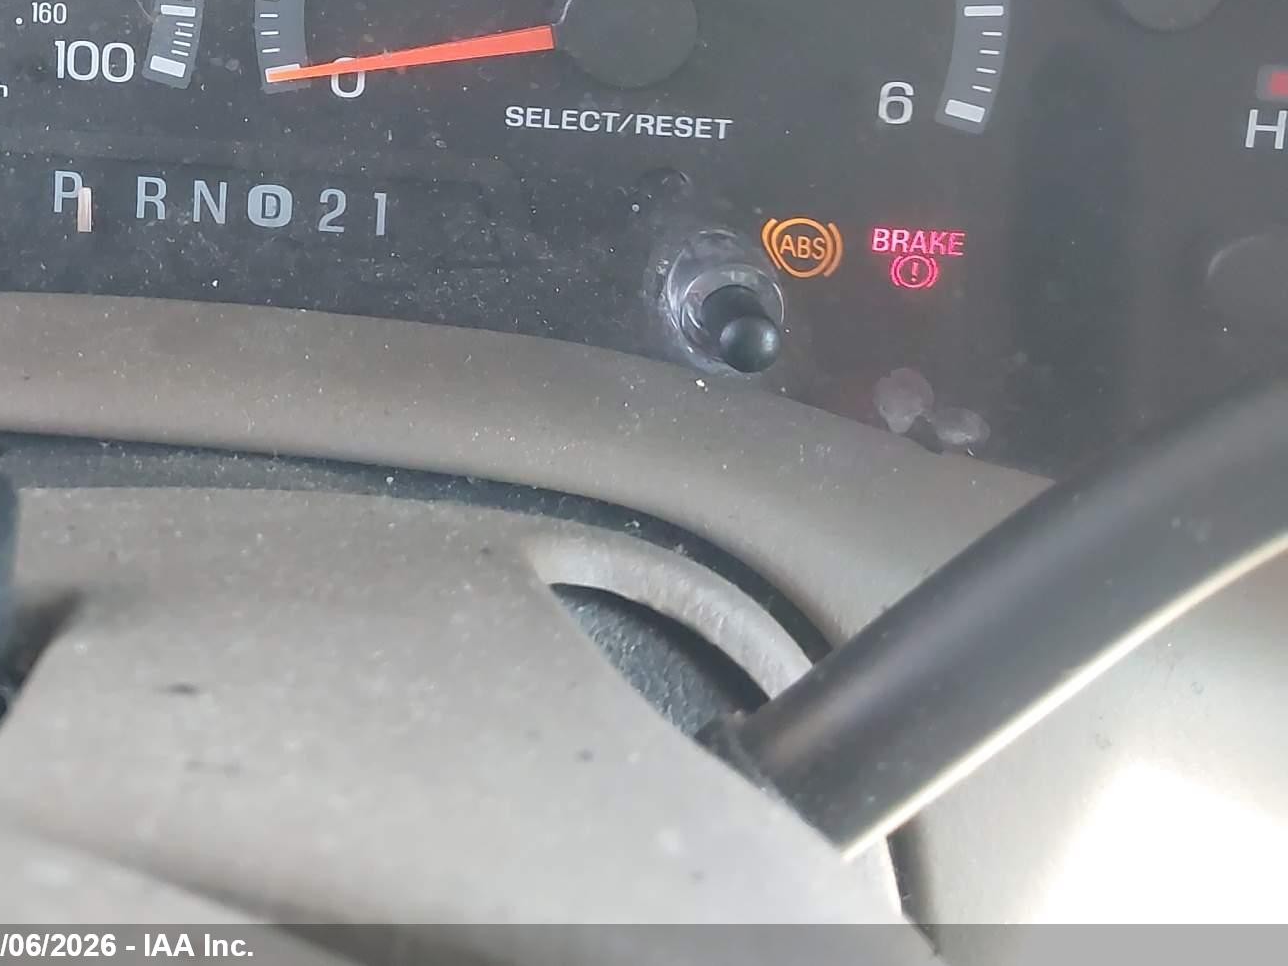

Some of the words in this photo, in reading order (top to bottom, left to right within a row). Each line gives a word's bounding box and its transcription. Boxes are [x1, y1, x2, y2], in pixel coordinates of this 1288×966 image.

[32, 2, 66, 23] 160
[55, 41, 134, 82] 100
[879, 82, 913, 124] 6
[506, 107, 733, 139] SELECT/RESET
[1246, 110, 1287, 149] H
[54, 171, 84, 213] P
[137, 177, 166, 219] R
[194, 181, 227, 224] N
[319, 189, 346, 232] 2
[374, 193, 386, 235] 1
[779, 234, 827, 261] ABS
[872, 229, 965, 256] BRAKE
